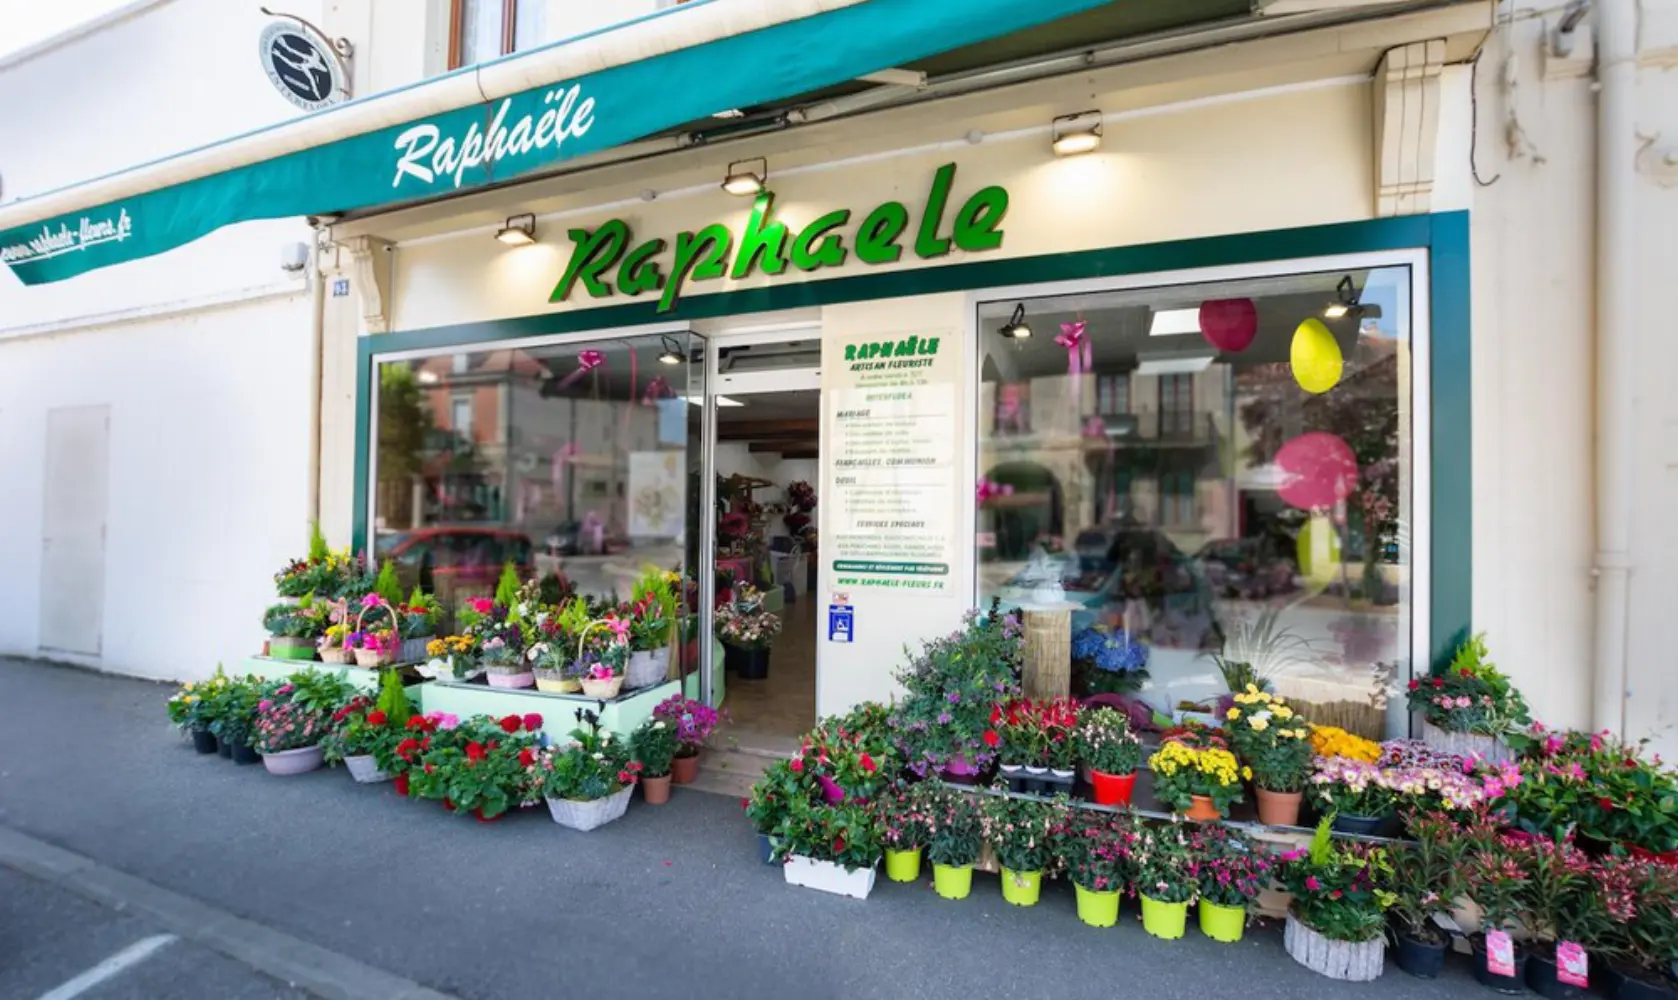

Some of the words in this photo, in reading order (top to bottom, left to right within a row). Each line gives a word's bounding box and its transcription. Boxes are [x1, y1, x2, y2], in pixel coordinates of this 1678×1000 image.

[392, 83, 595, 188] Raphaële
[548, 162, 1009, 313] Raphaele
[844, 335, 940, 361] RAPHAËLE
[850, 361, 885, 371] ARTISAN
[888, 358, 934, 369] FLEURISTE
[836, 409, 870, 418] MARIAGE
